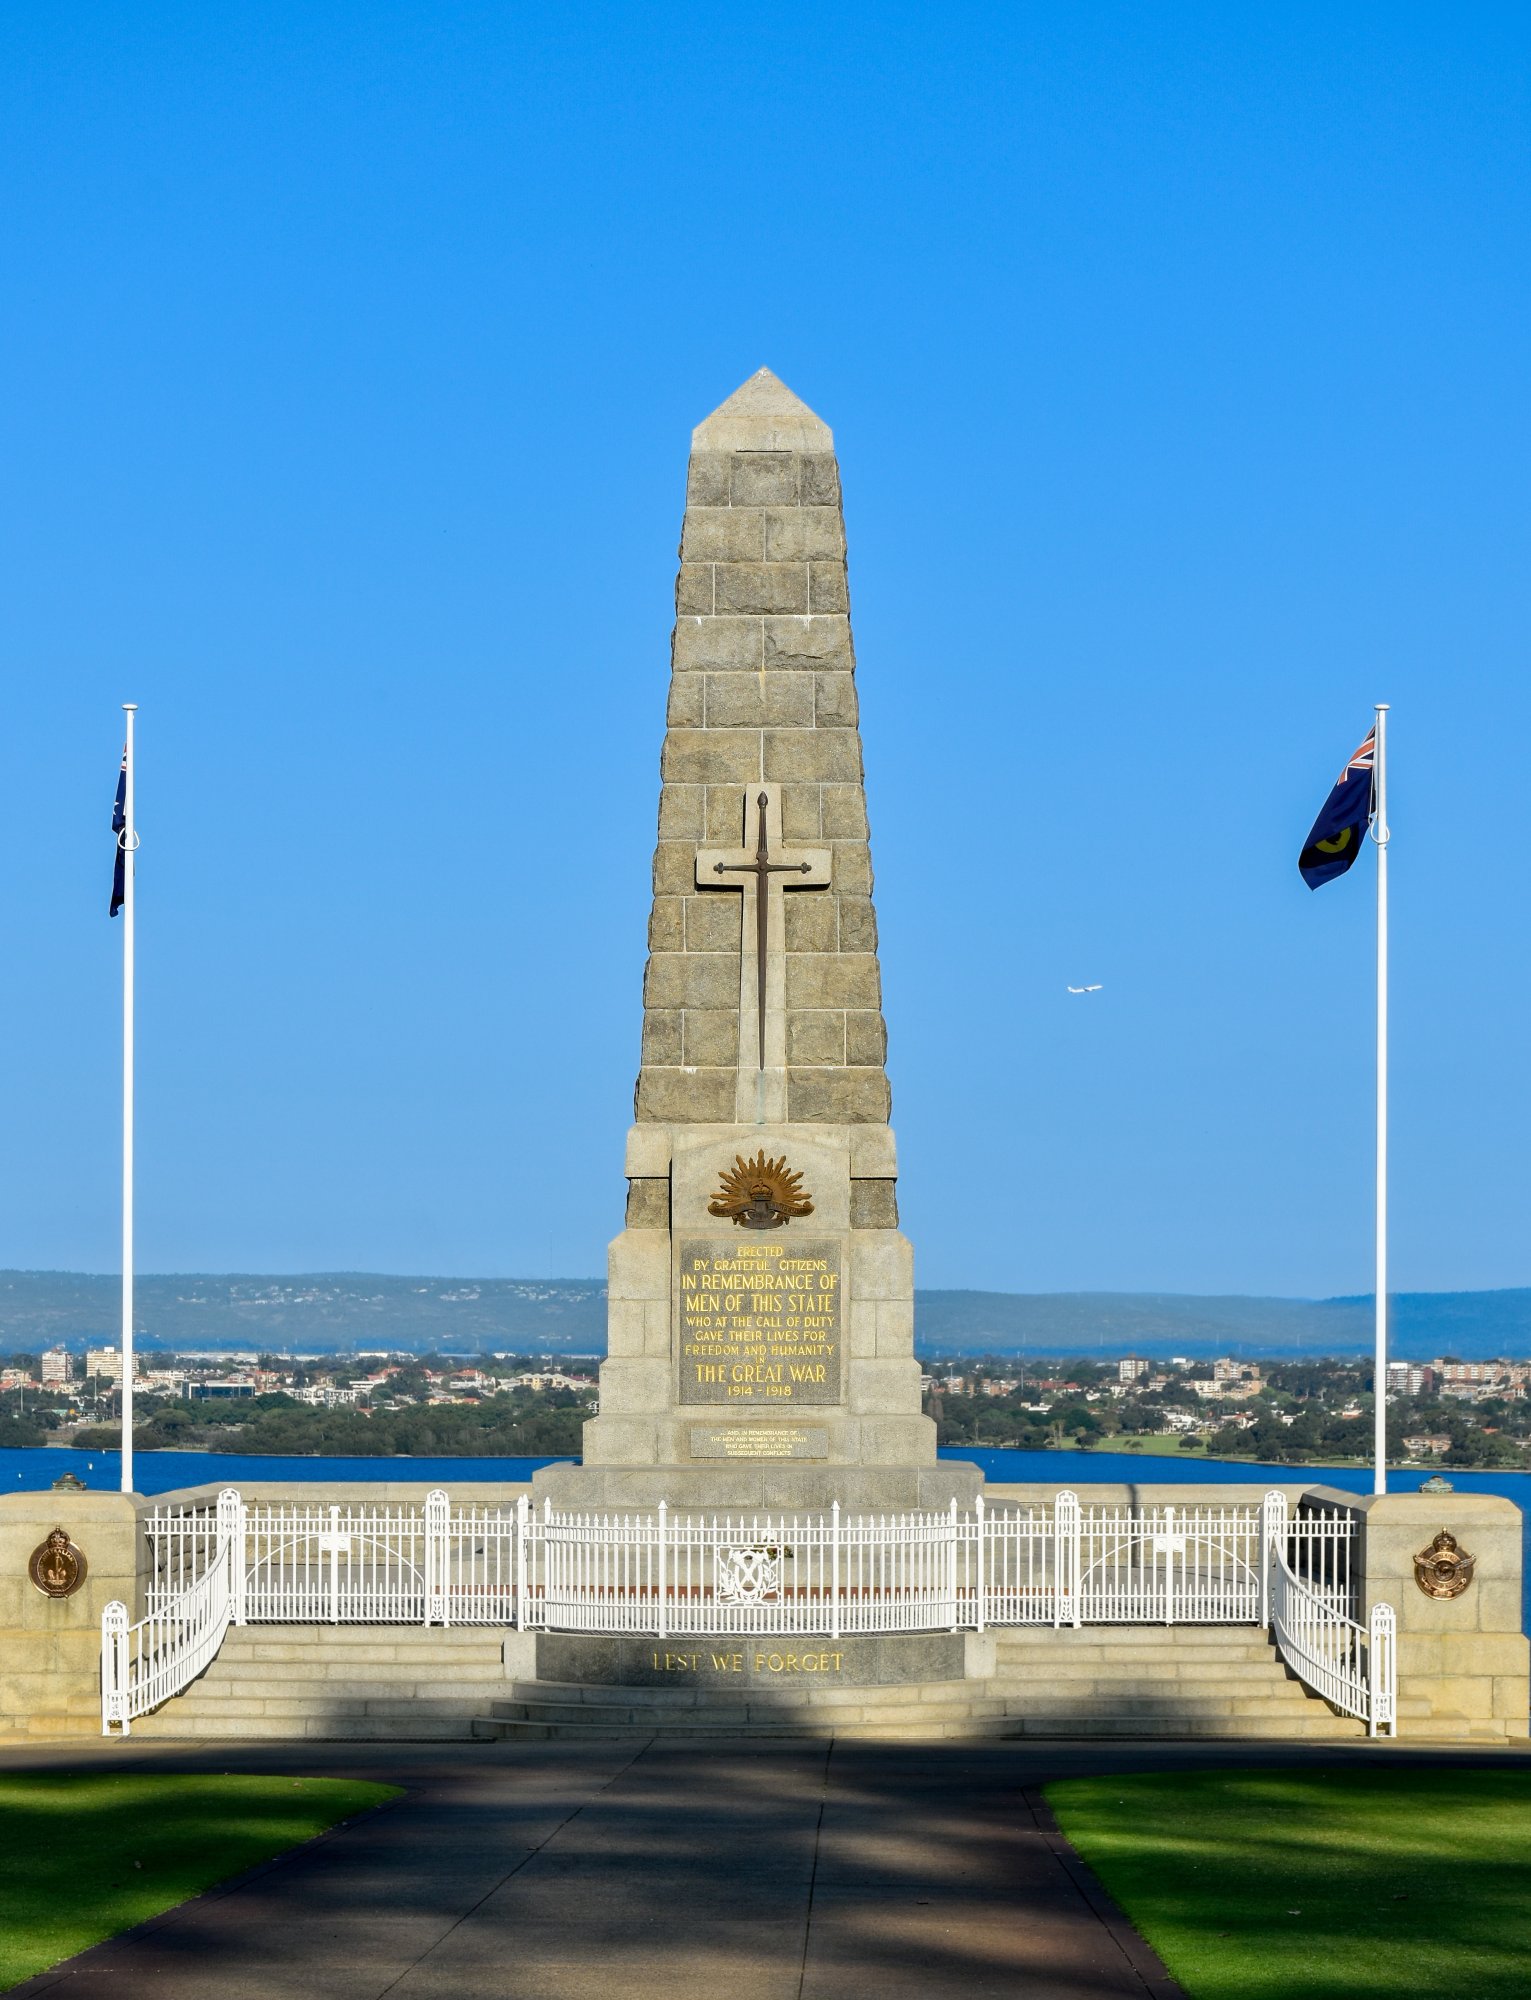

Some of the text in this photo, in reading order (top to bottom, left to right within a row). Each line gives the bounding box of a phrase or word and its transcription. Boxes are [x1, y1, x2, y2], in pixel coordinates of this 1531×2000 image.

[737, 1246, 783, 1256] ERECTED
[694, 1261, 827, 1270] BY GRATEFUL CITIZENS
[682, 1275, 838, 1290] IN REMEMBRANCE OF
[686, 1294, 833, 1312] MEN OF THIS STATE
[686, 1317, 834, 1327] WHO AT THE CALL OF DUTY
[696, 1331, 826, 1341] GAVE THEIR LIVES FOR
[685, 1345, 834, 1355] FREEDOM AND HUMANITY
[696, 1365, 826, 1382] THE GREAT WAR
[728, 1386, 752, 1396] 1914
[766, 1386, 792, 1396] 1918
[652, 1653, 844, 1671] LEST WE FORGET
